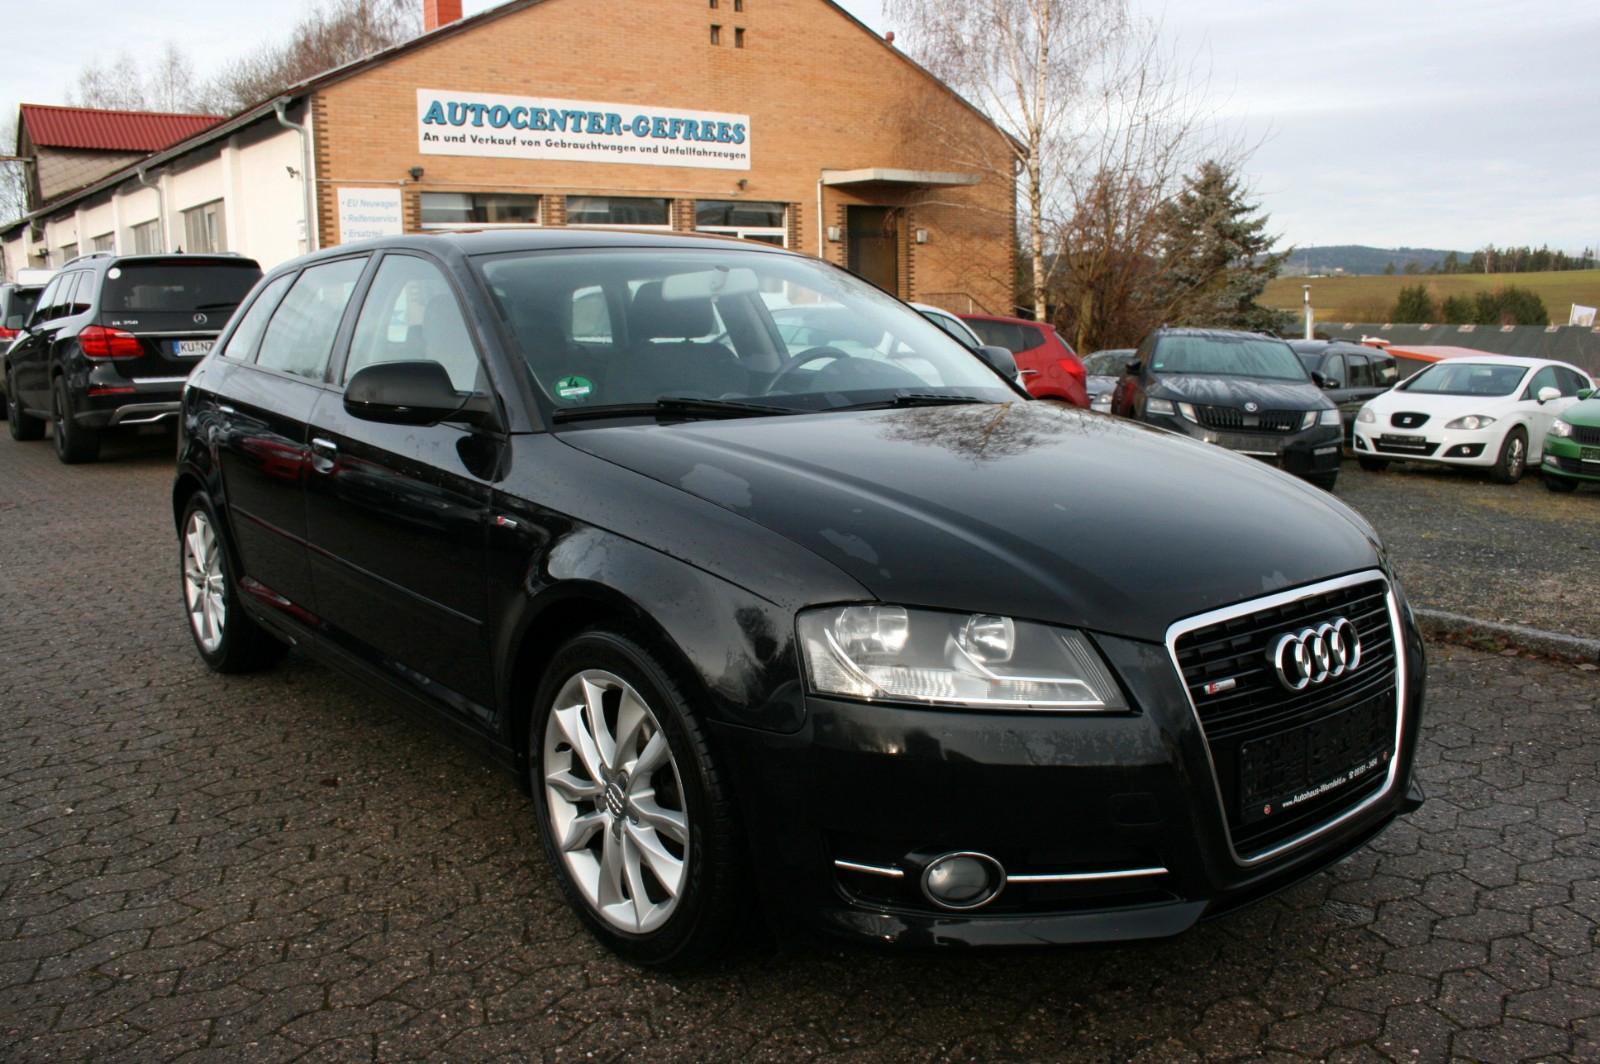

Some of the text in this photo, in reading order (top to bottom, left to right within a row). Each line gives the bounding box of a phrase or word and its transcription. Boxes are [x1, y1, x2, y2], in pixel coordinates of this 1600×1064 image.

[422, 100, 746, 145] AUTOCENTER-GEFREES
[423, 132, 746, 160] An und Verkauf von Gebrauchtwagen und Unfallfahrzeugen
[567, 377, 579, 388] 4
